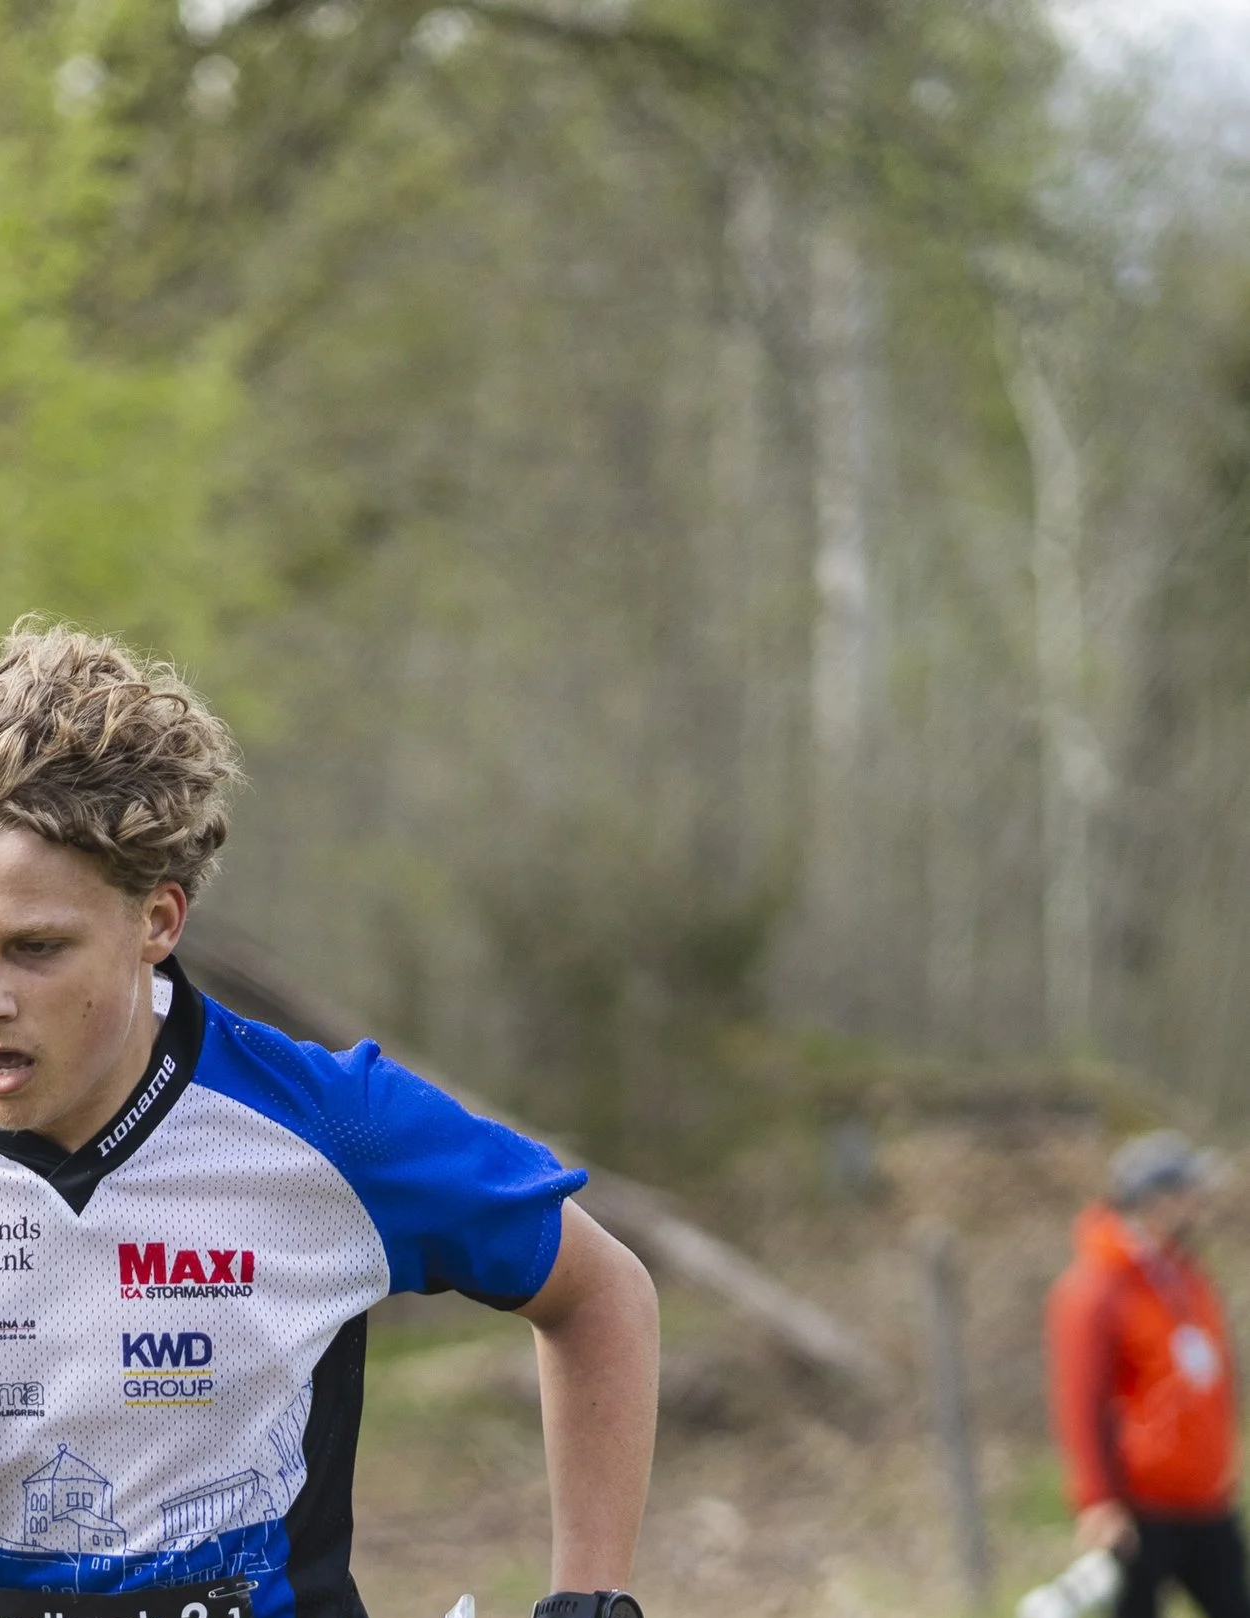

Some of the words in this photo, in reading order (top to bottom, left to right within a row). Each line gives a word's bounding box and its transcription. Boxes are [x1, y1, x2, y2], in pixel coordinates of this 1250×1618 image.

[97, 1053, 176, 1158] noname
[118, 1242, 255, 1285] MAXI
[120, 1286, 143, 1299] ICA
[145, 1285, 254, 1300] STORMARKNAD
[21, 1319, 36, 1329] AB
[122, 1332, 212, 1368] KWD
[123, 1379, 213, 1398] GROUP
